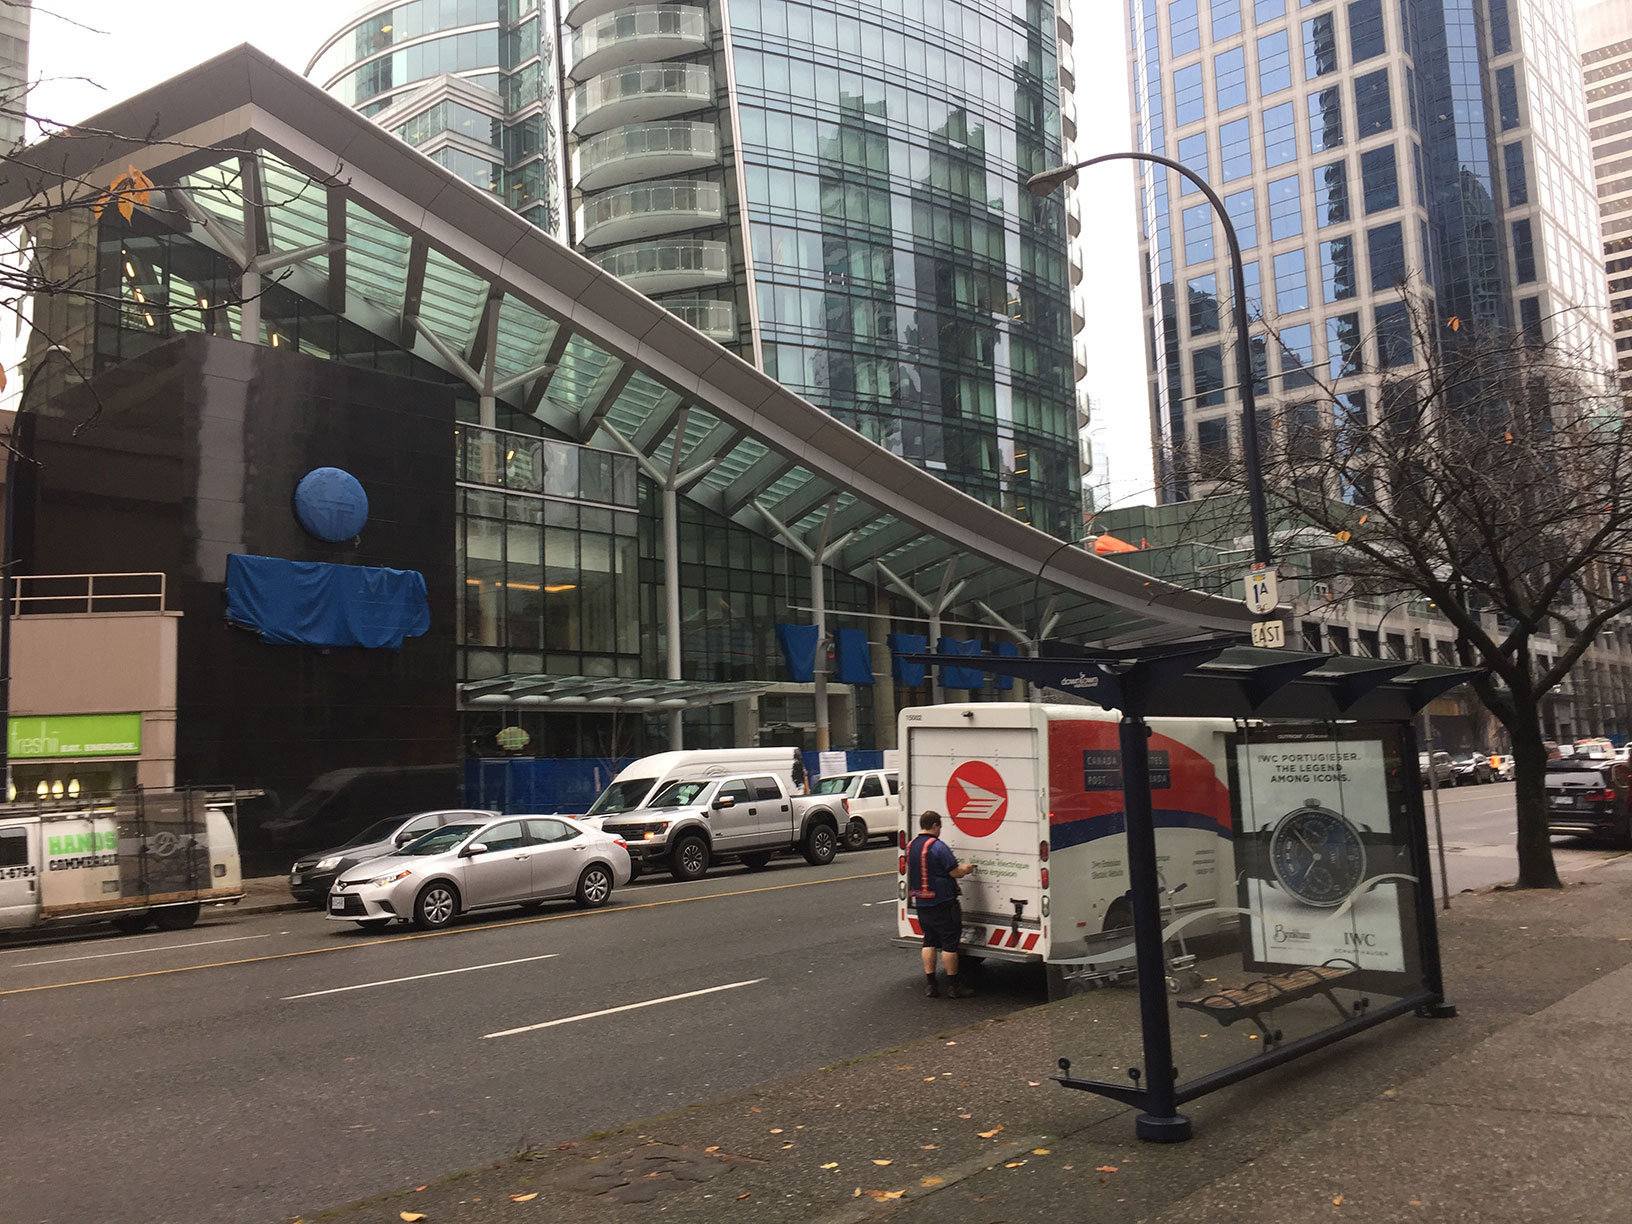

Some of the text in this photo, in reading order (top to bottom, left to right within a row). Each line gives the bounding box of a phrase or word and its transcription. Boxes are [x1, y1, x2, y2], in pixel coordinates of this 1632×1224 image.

[1253, 582, 1269, 604] 1A
[1253, 625, 1281, 643] EAST
[1061, 674, 1098, 686] downtown
[1087, 756, 1117, 765] CANADA
[1257, 754, 1278, 762] IWC
[1275, 763, 1342, 772] THE LEGEND
[1087, 775, 1106, 785] POST
[1270, 774, 1310, 783] AMONG
[1344, 932, 1376, 947] IWC
